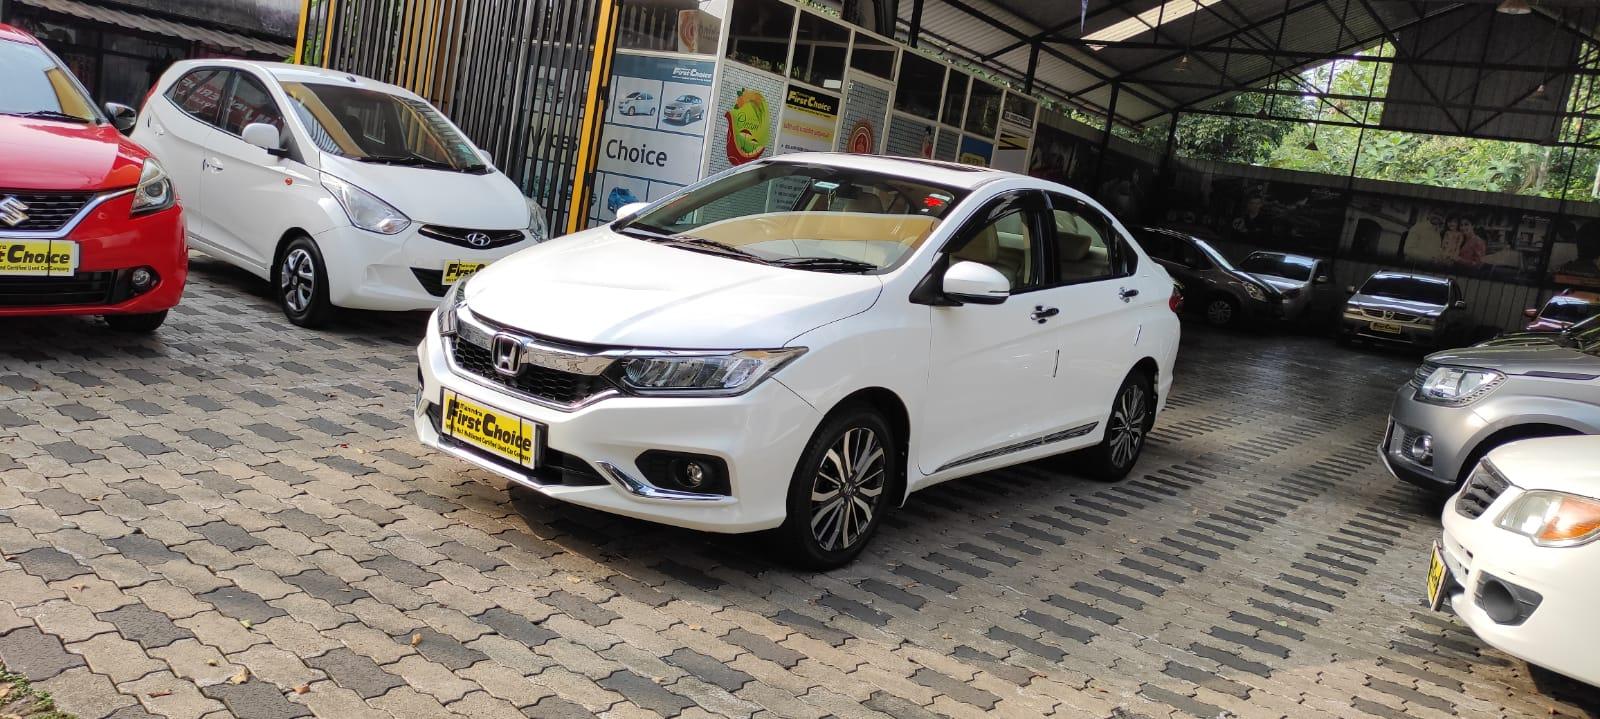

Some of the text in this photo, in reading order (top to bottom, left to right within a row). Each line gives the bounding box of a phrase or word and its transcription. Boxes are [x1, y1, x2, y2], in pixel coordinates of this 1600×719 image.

[788, 90, 808, 106] First
[807, 96, 833, 112] Choice
[606, 138, 668, 168] Choice
[7, 244, 71, 264] Choice
[447, 399, 532, 451] First Choice
